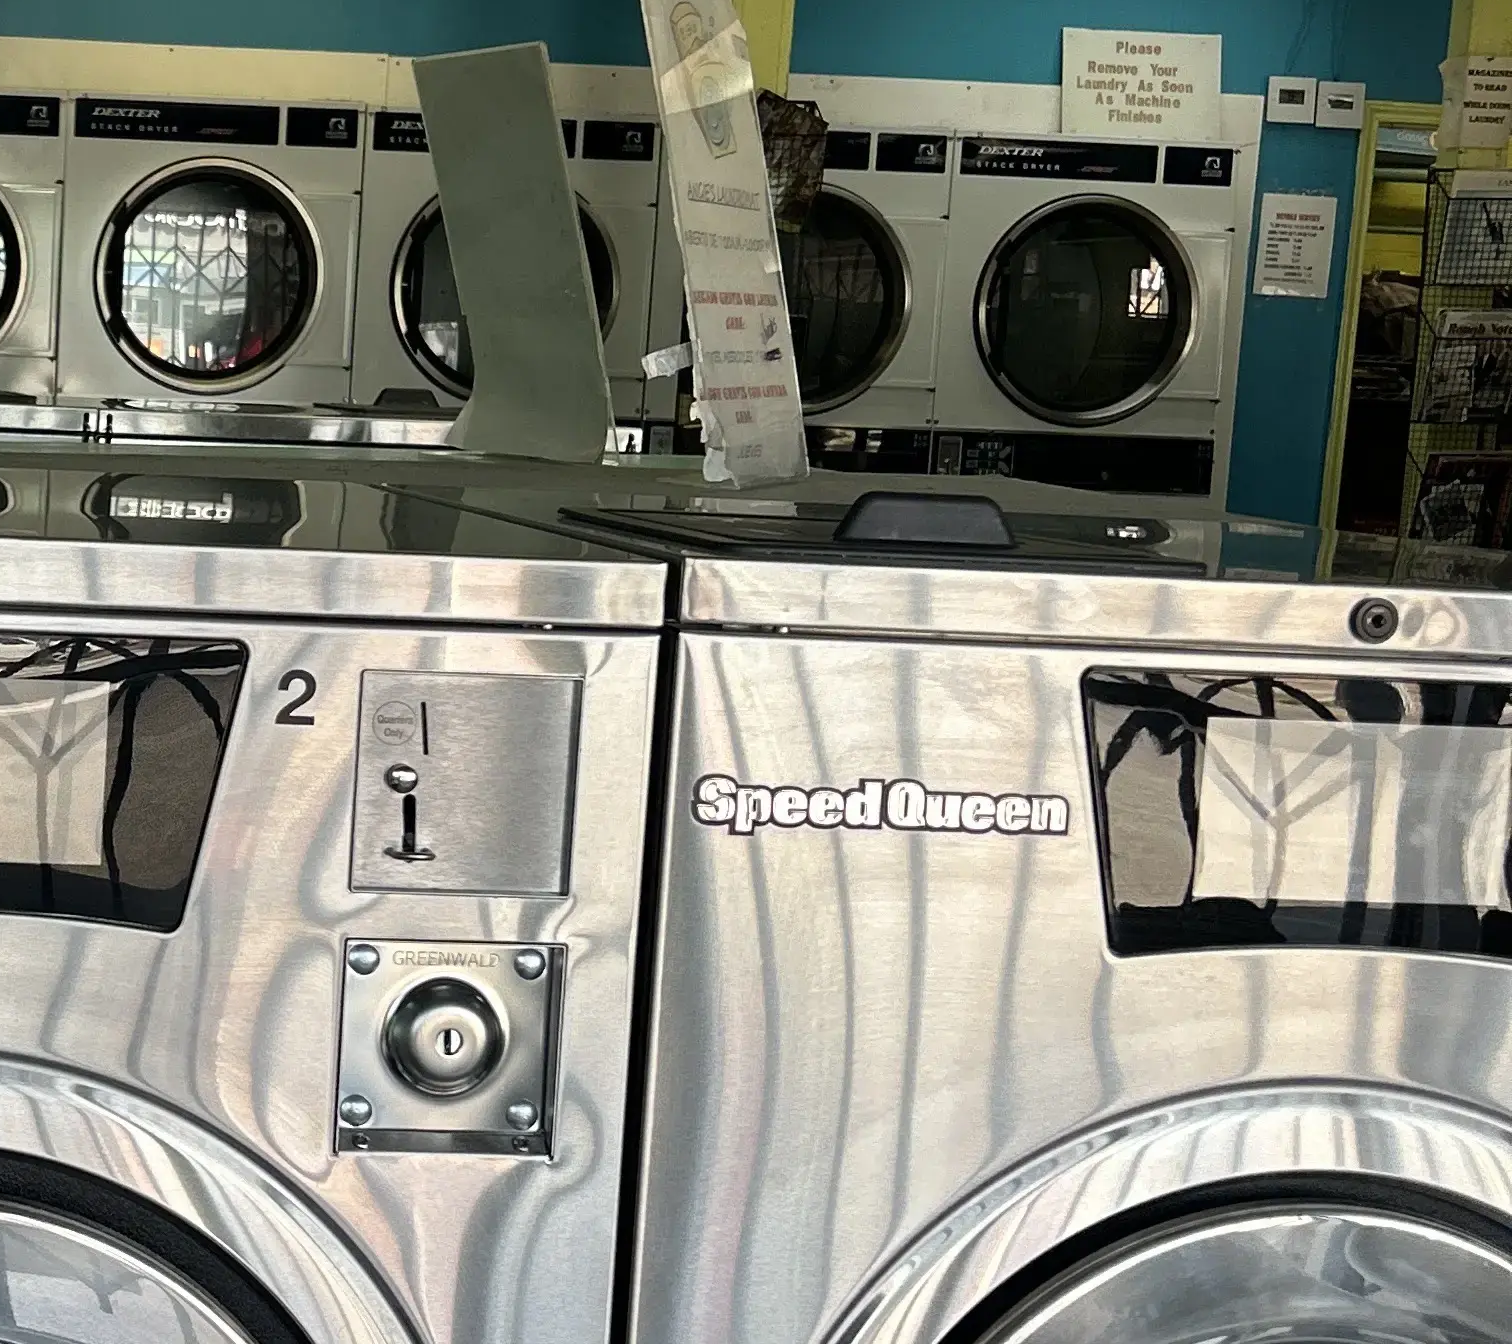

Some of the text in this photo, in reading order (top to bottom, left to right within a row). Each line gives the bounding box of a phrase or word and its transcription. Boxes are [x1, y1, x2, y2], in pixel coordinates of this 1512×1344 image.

[1115, 41, 1162, 55] Please
[1087, 60, 1178, 77] Remove Your
[1076, 76, 1194, 94] Laundry As Soon
[1095, 92, 1181, 108] As Machine
[91, 107, 161, 118] DEXTER
[1107, 109, 1162, 124] Finishes
[1469, 115, 1506, 124] LAUNDRY
[979, 145, 1044, 157] DEXTER
[275, 669, 317, 725] 2
[377, 714, 414, 725] Quarters
[384, 728, 405, 739] Only
[392, 950, 501, 968] GREENWALD
